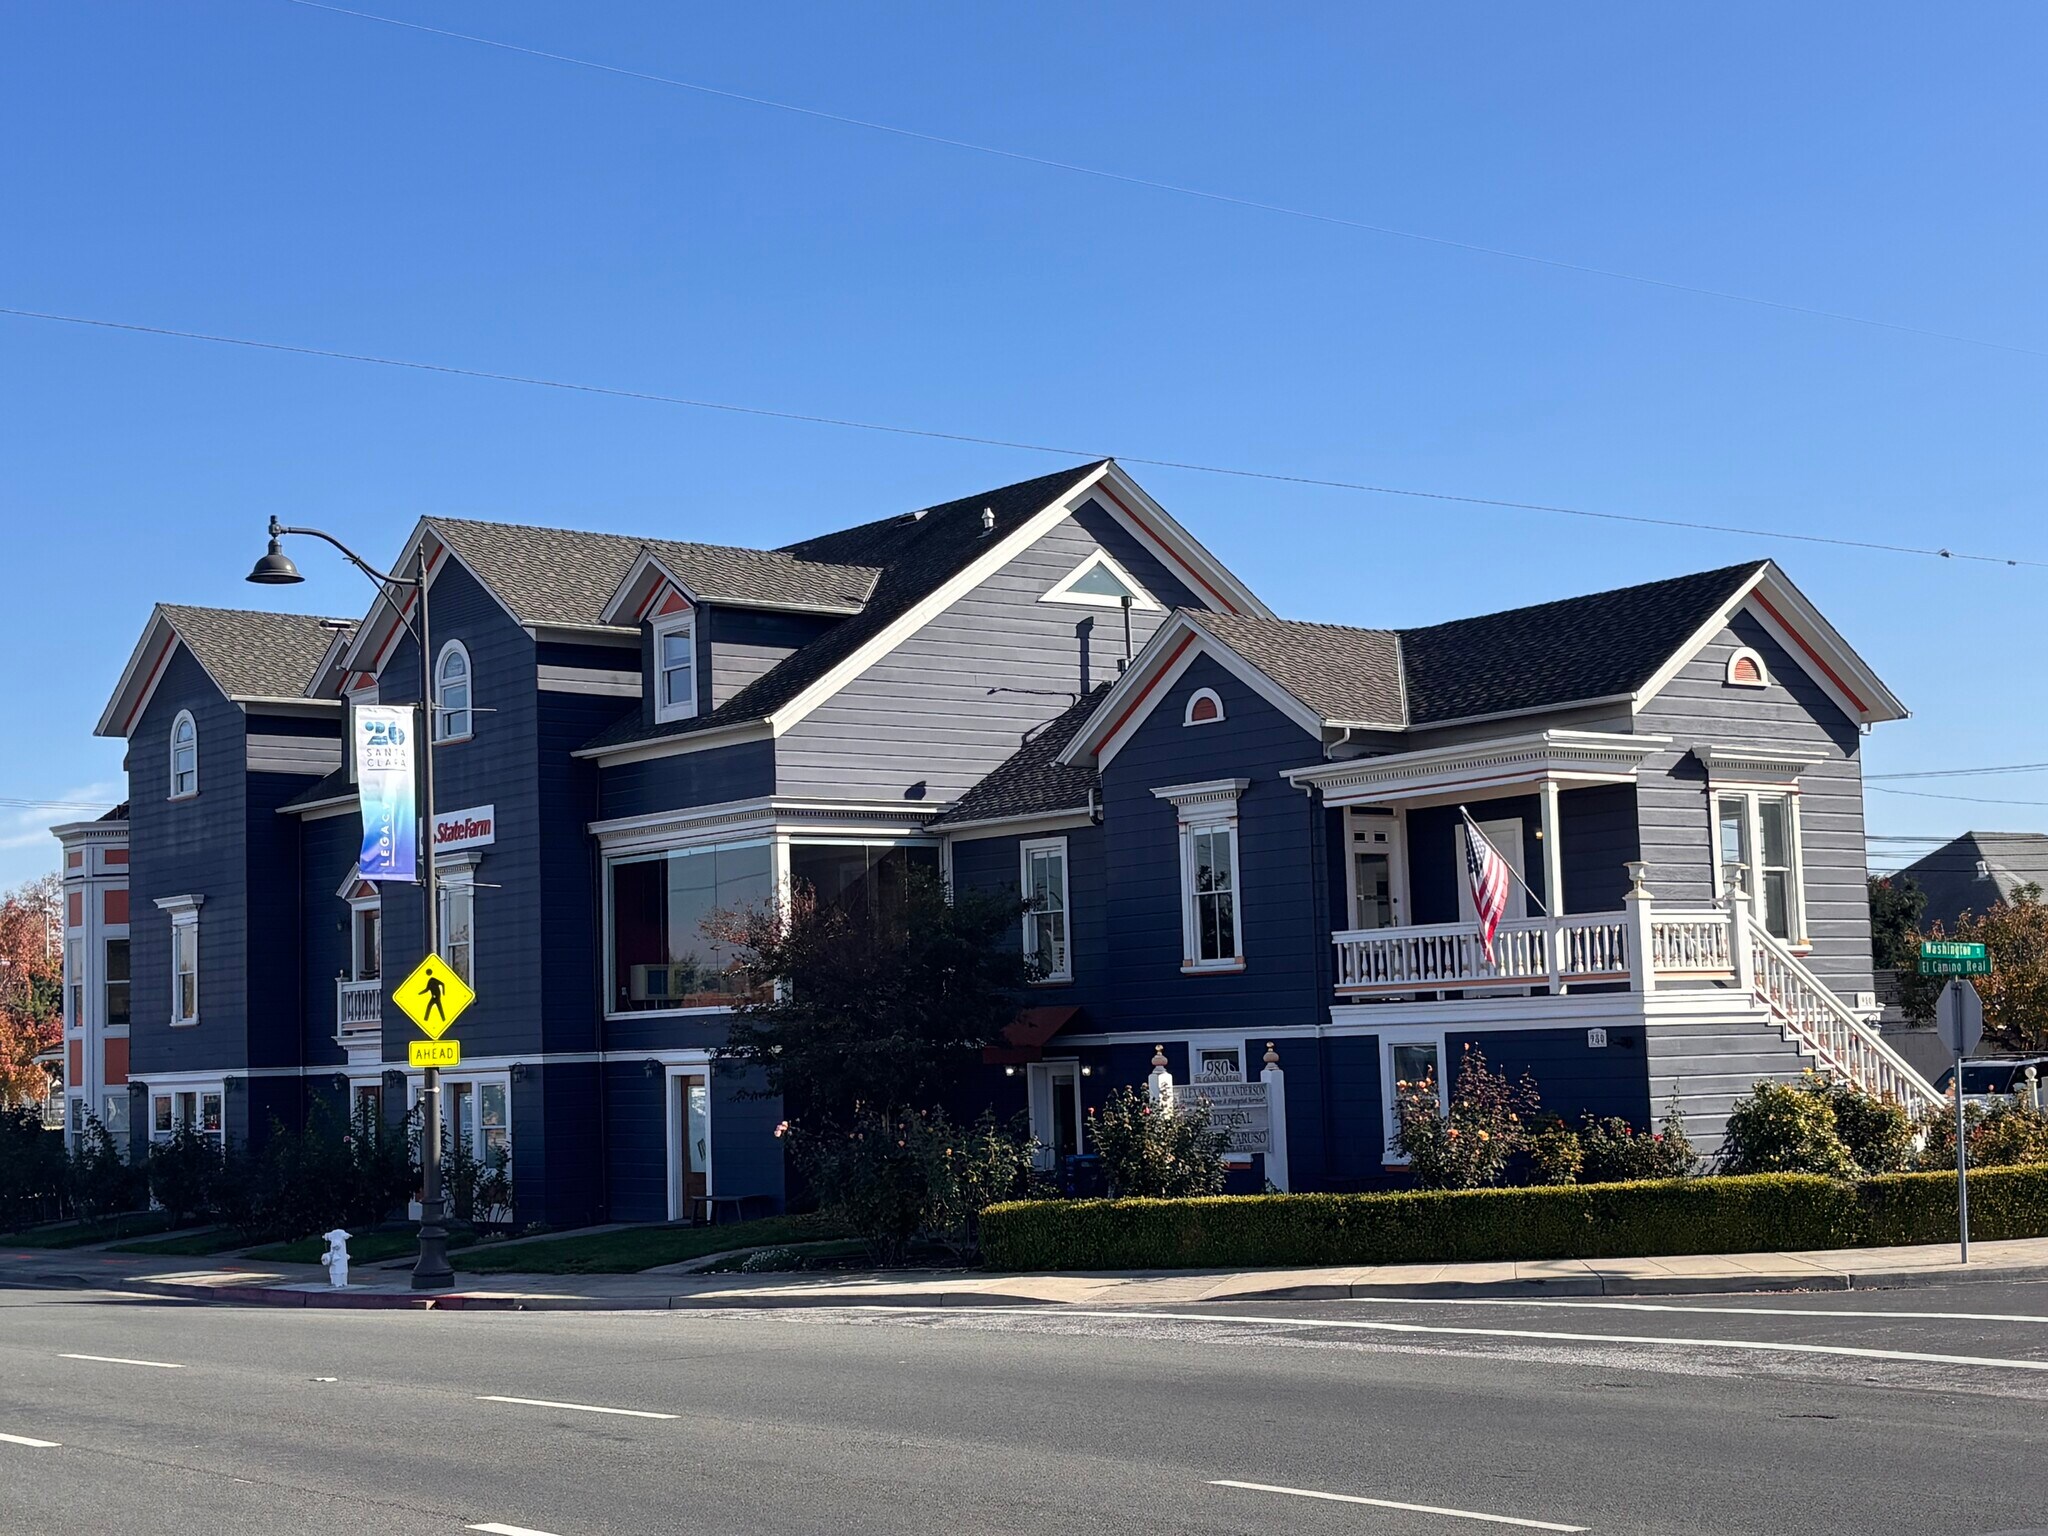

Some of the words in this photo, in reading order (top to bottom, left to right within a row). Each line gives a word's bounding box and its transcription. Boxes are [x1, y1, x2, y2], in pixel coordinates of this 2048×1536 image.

[366, 748, 406, 757] SANTA
[367, 758, 406, 767] CLARA
[379, 803, 390, 867] LEGACY
[1925, 943, 1971, 958] Washington
[1922, 961, 1929, 973] El
[1932, 961, 1962, 973] Camino
[1966, 960, 1986, 972] Real
[416, 1047, 454, 1059] AHEAD
[1206, 1060, 1229, 1076] 980
[1181, 1087, 1220, 1099] ALEXANDRA
[1231, 1084, 1266, 1096] ANDERSON
